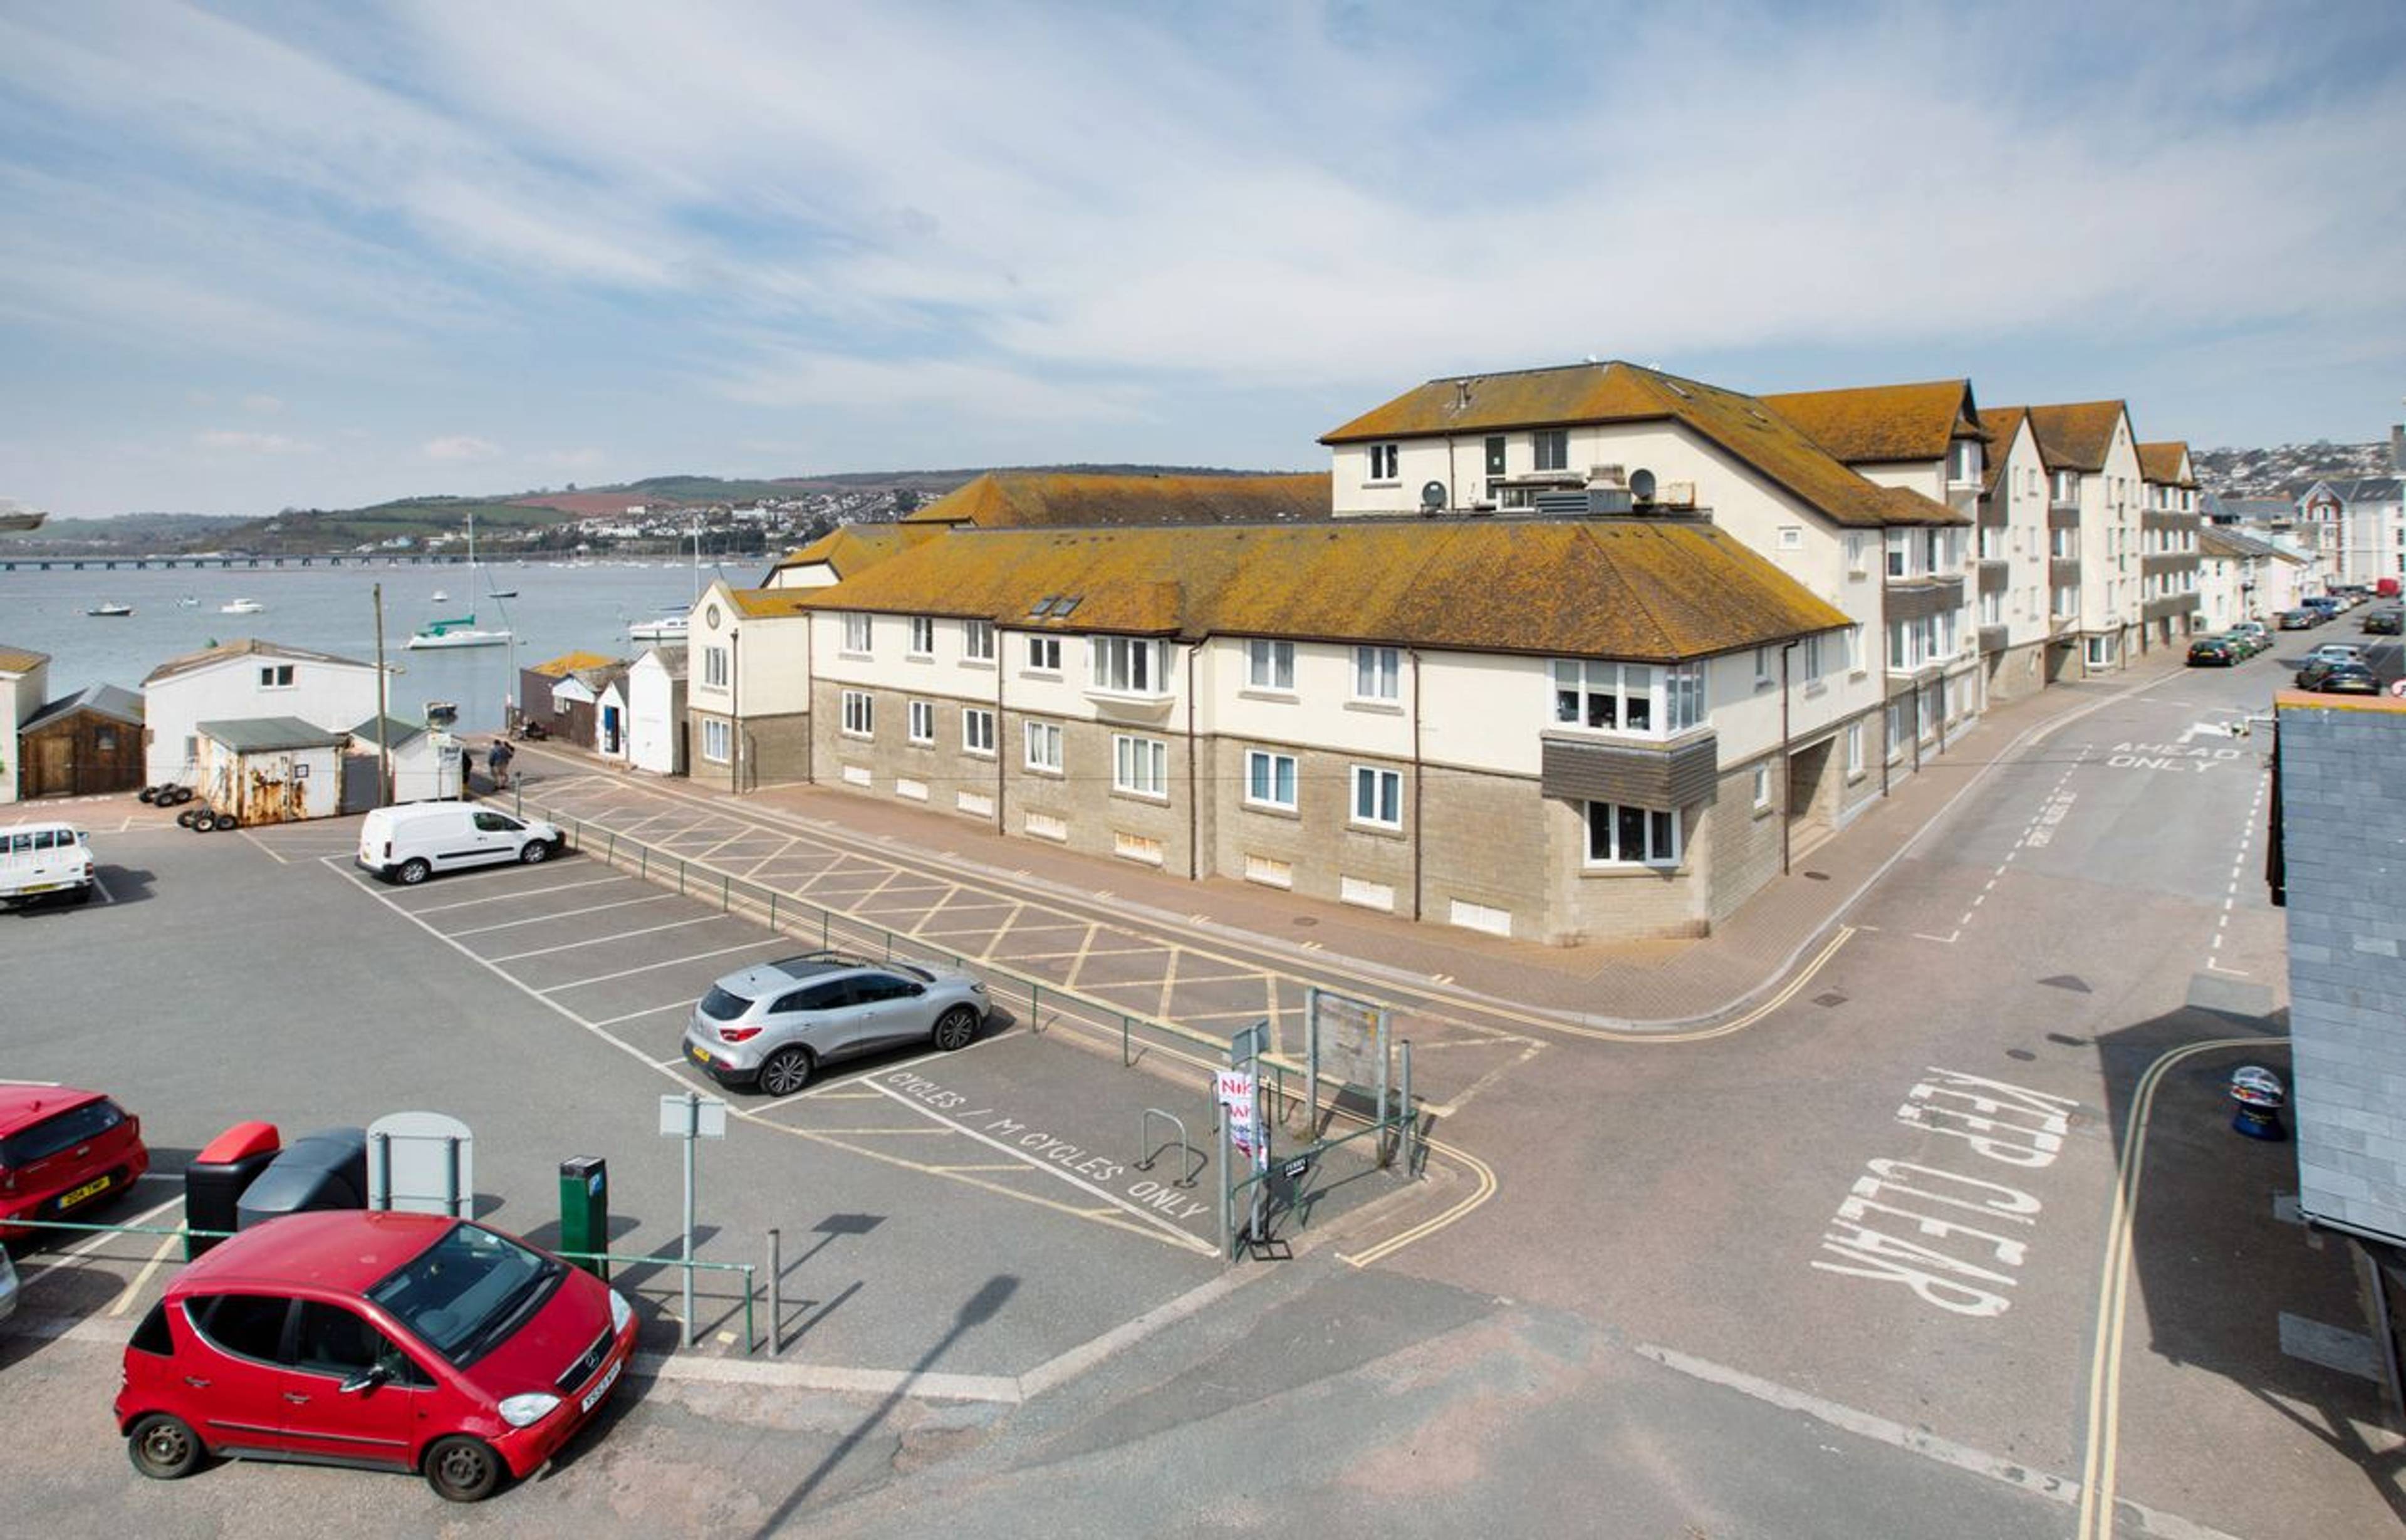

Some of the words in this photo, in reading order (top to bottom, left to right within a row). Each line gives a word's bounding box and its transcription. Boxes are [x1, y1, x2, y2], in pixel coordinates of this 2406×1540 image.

[2107, 755, 2219, 773] ONLY
[2112, 742, 2241, 760] AHEAD
[887, 1071, 966, 1109] CYCLES
[956, 1108, 993, 1117] /
[1019, 1132, 1125, 1182] CYCLES
[1128, 1180, 1209, 1219] ONLY
[1893, 1066, 2080, 1168] KEEP
[1810, 1158, 2042, 1317] CLEAR
